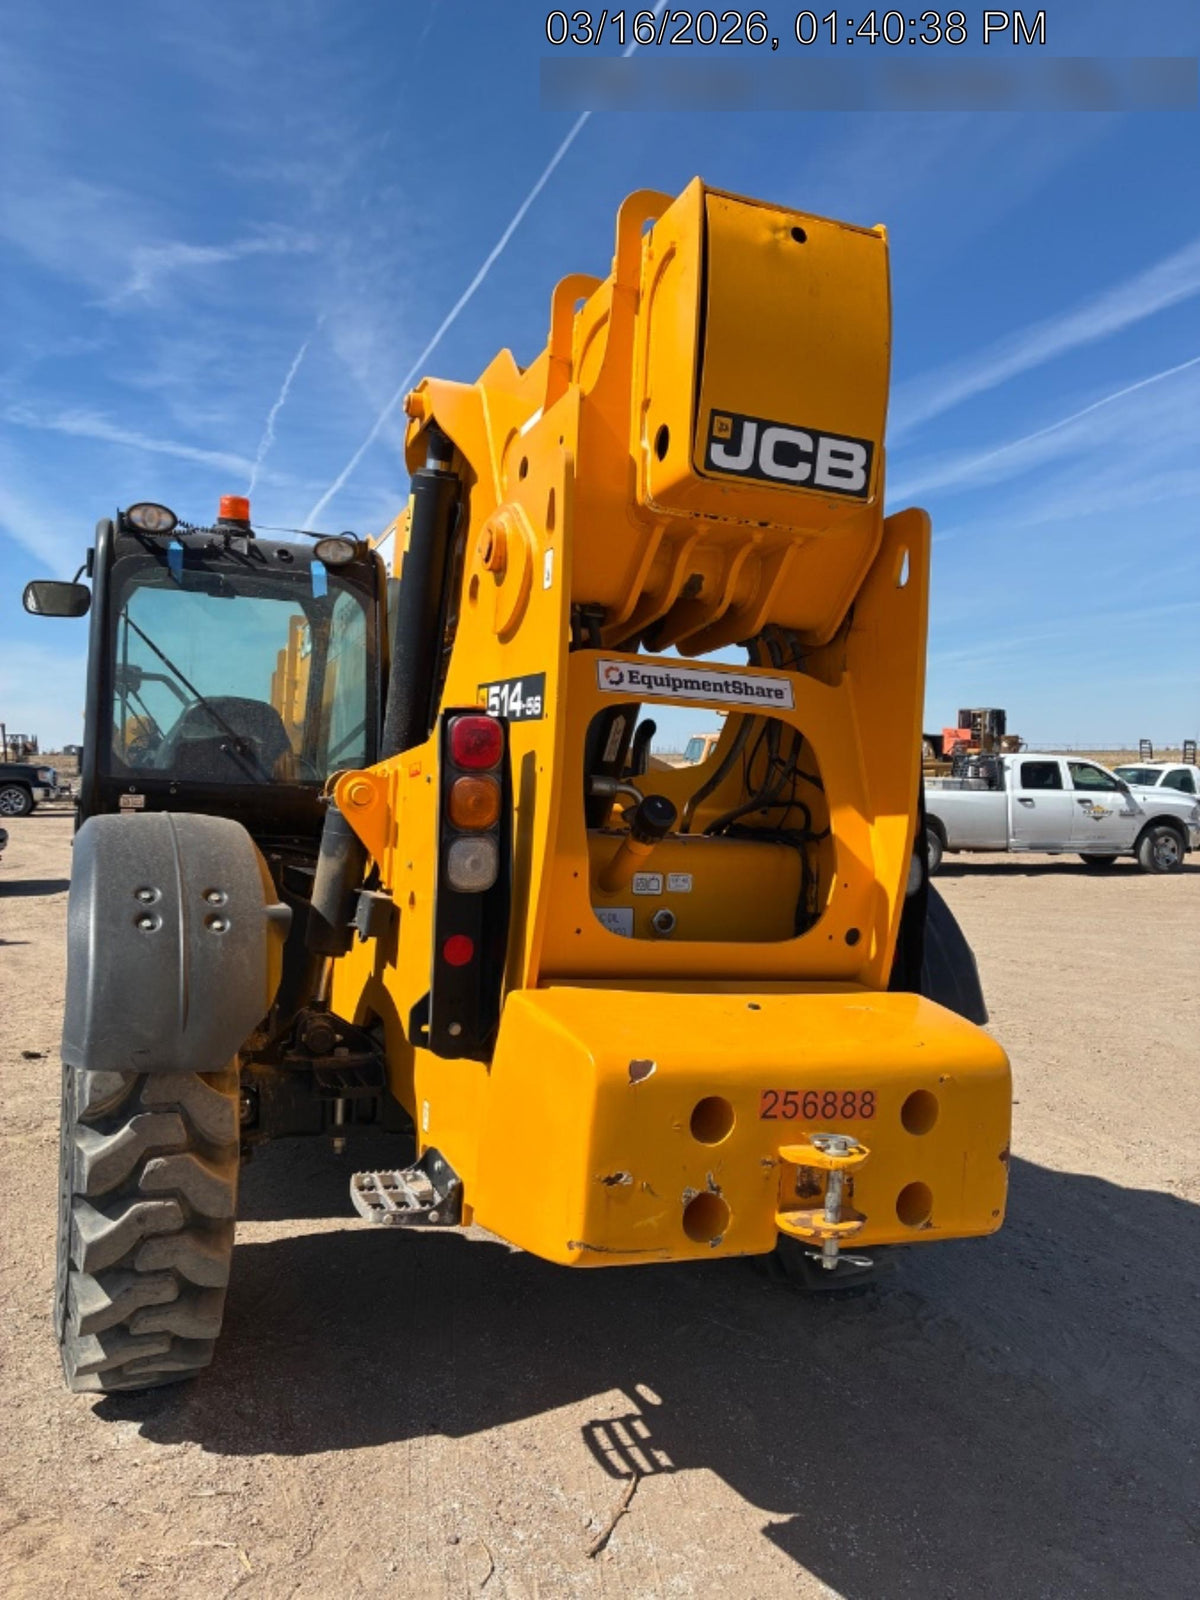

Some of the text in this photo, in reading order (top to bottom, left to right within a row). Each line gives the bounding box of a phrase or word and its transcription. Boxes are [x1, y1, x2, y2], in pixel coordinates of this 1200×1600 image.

[711, 421, 867, 491] JCB
[627, 669, 785, 700] EquipmentShare
[760, 1089, 875, 1120] 256888
